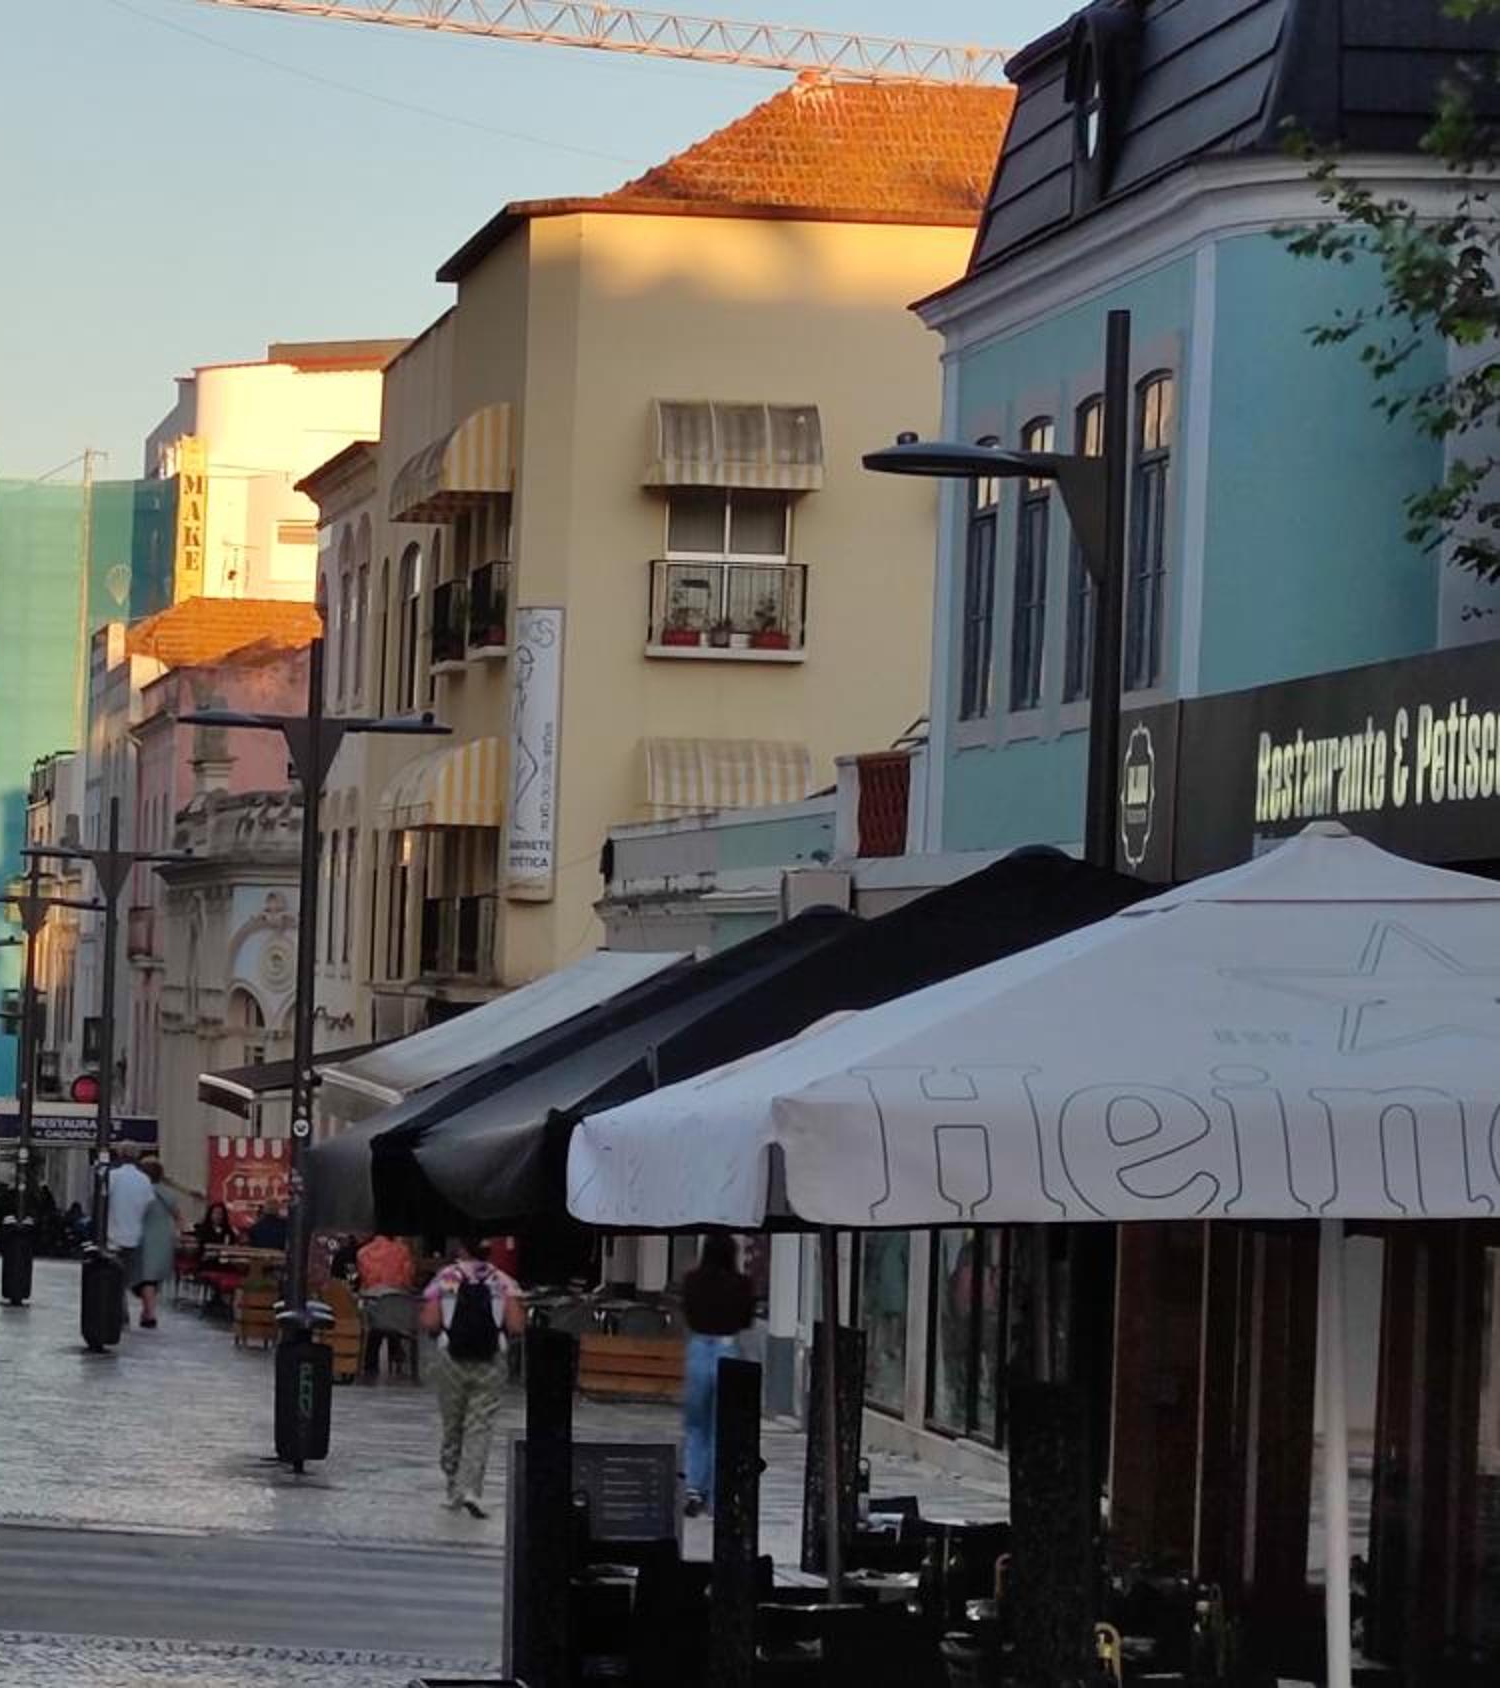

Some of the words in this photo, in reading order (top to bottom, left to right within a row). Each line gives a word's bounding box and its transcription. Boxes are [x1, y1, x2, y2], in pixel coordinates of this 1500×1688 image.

[183, 474, 203, 571] MAKE
[1255, 716, 1387, 823] Restaurante
[1392, 707, 1409, 808] &
[32, 1117, 122, 1132] RESTAURAE
[847, 1063, 1500, 1217] Hein
